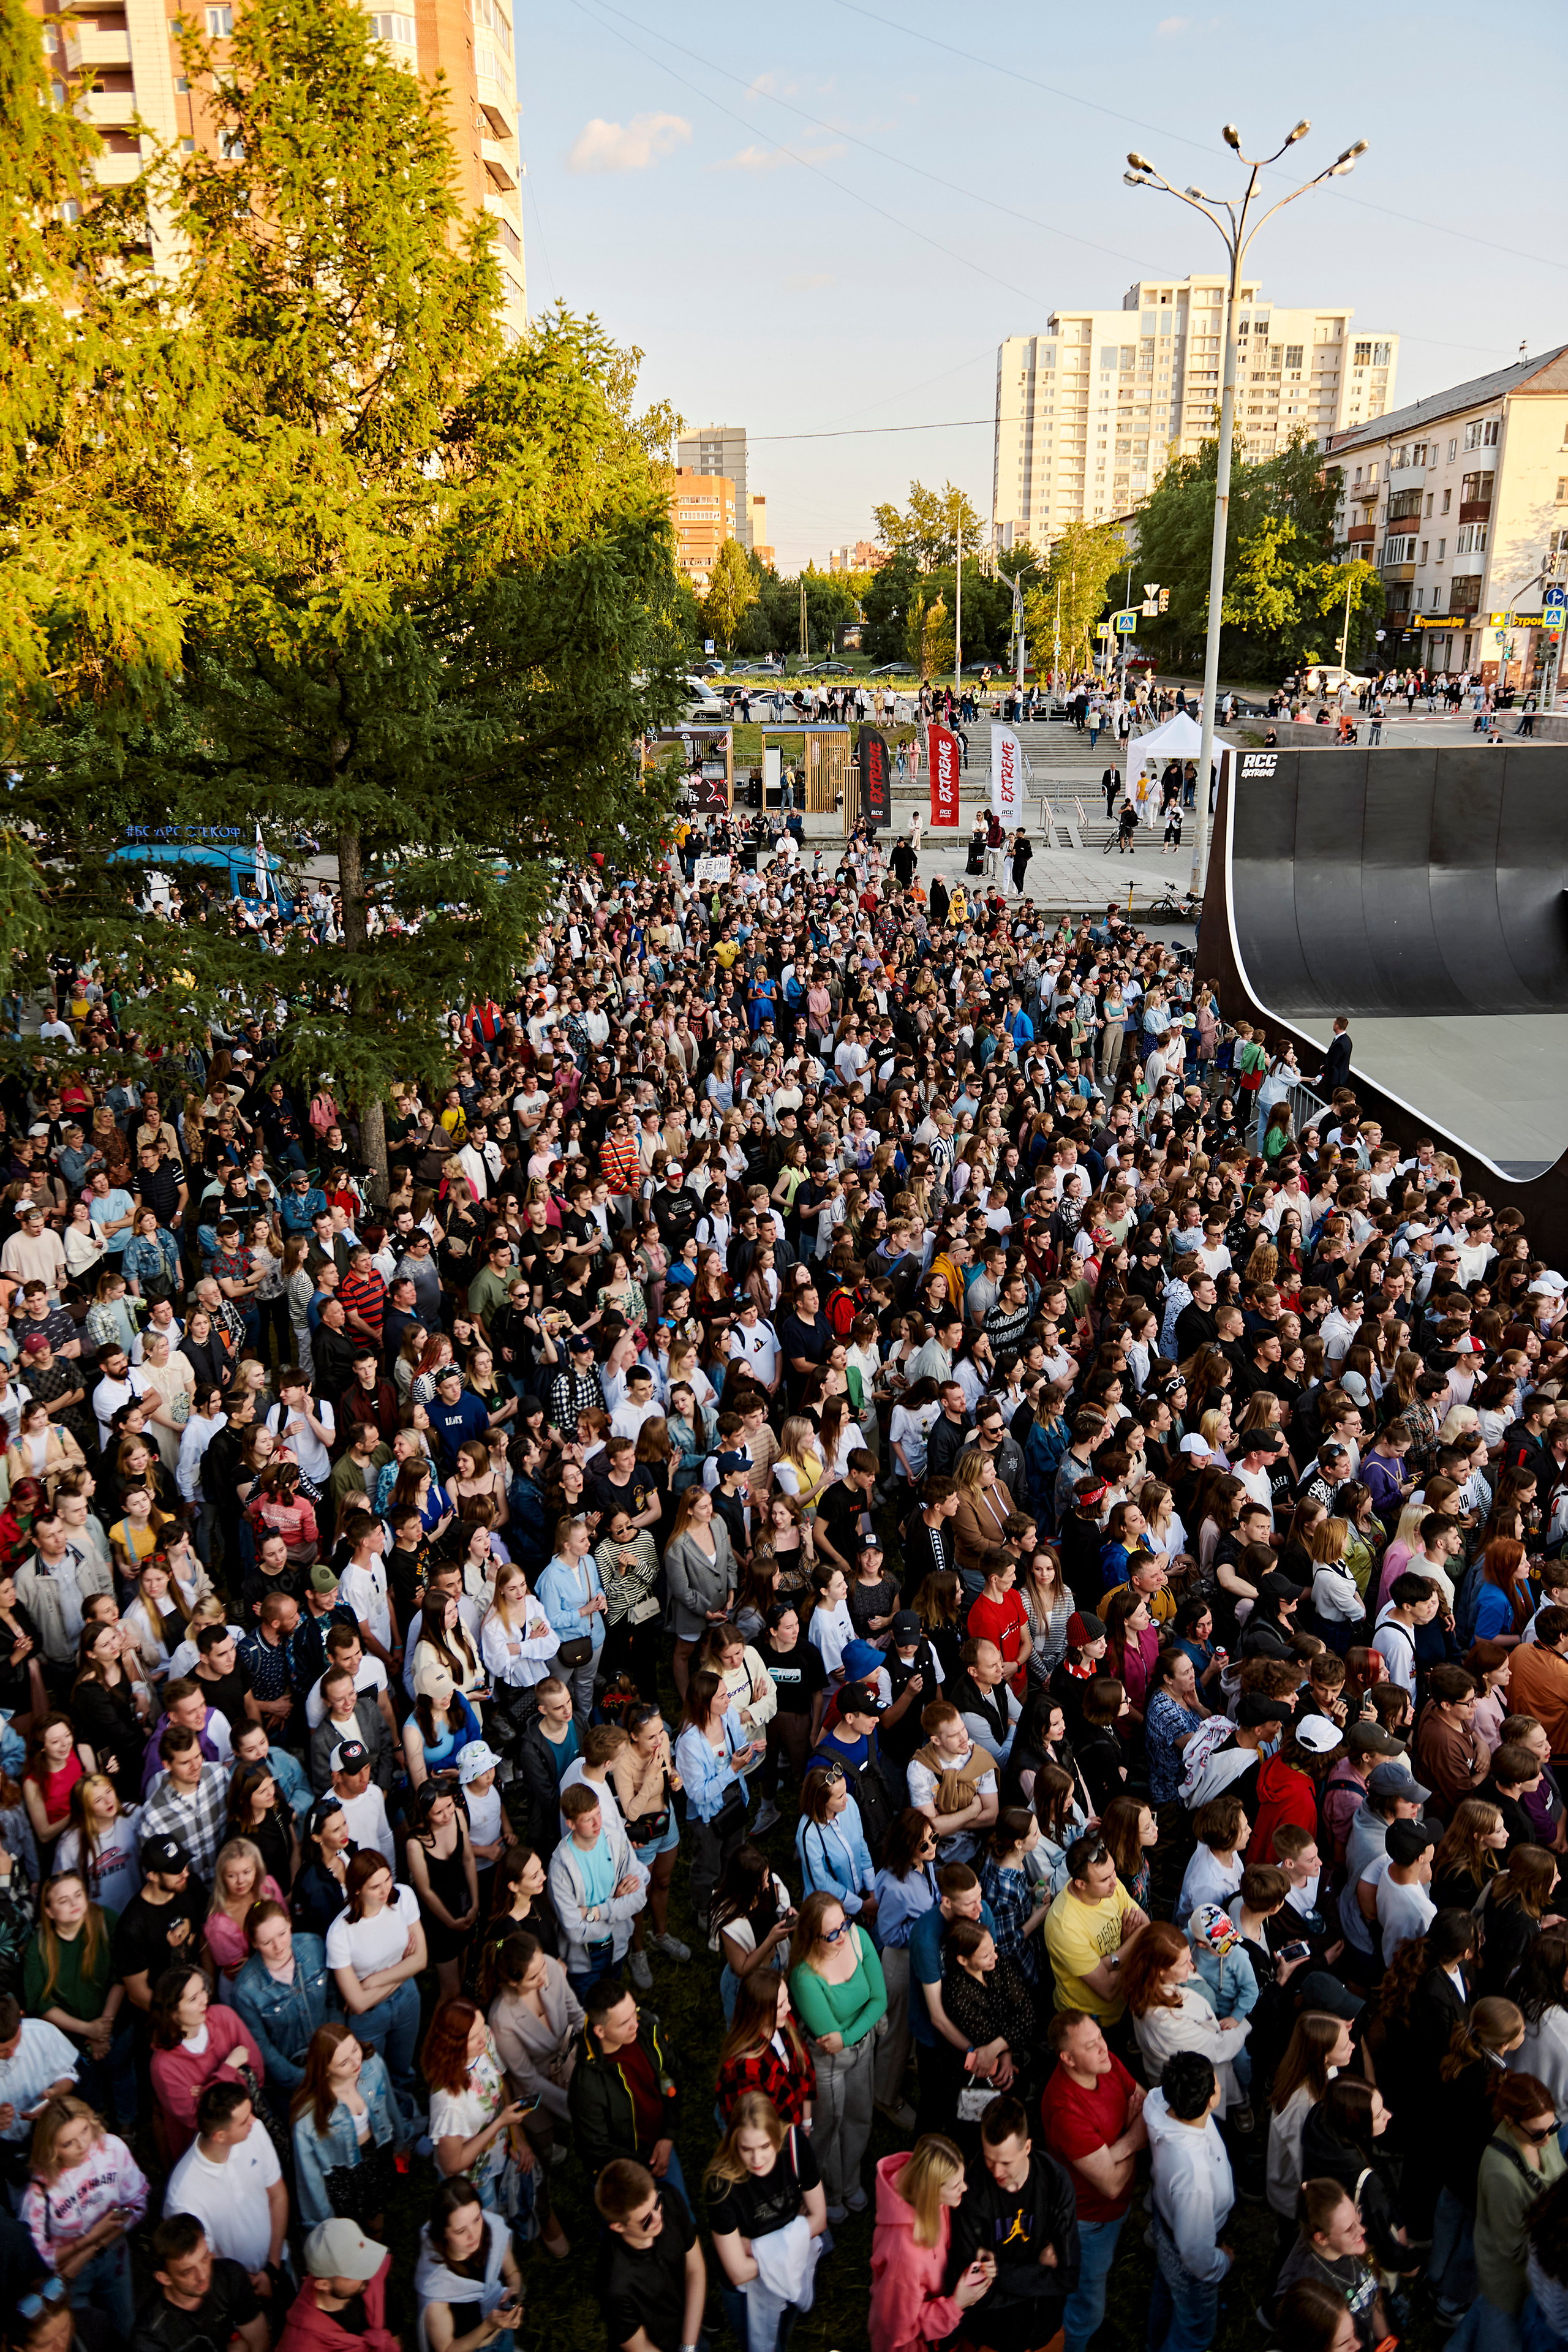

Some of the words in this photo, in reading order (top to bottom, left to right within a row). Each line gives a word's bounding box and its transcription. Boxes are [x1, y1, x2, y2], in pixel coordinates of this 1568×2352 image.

[1243, 754, 1278, 767] RCC
[869, 741, 883, 804] EXTREME
[938, 739, 954, 803] EXTREME
[1000, 740, 1016, 803] EXTREME
[1241, 768, 1275, 778] EXTREME
[698, 859, 729, 870] ВЕРНИ
[696, 870, 714, 880] ДОЛГ
[526, 1102, 541, 1114] NIKE
